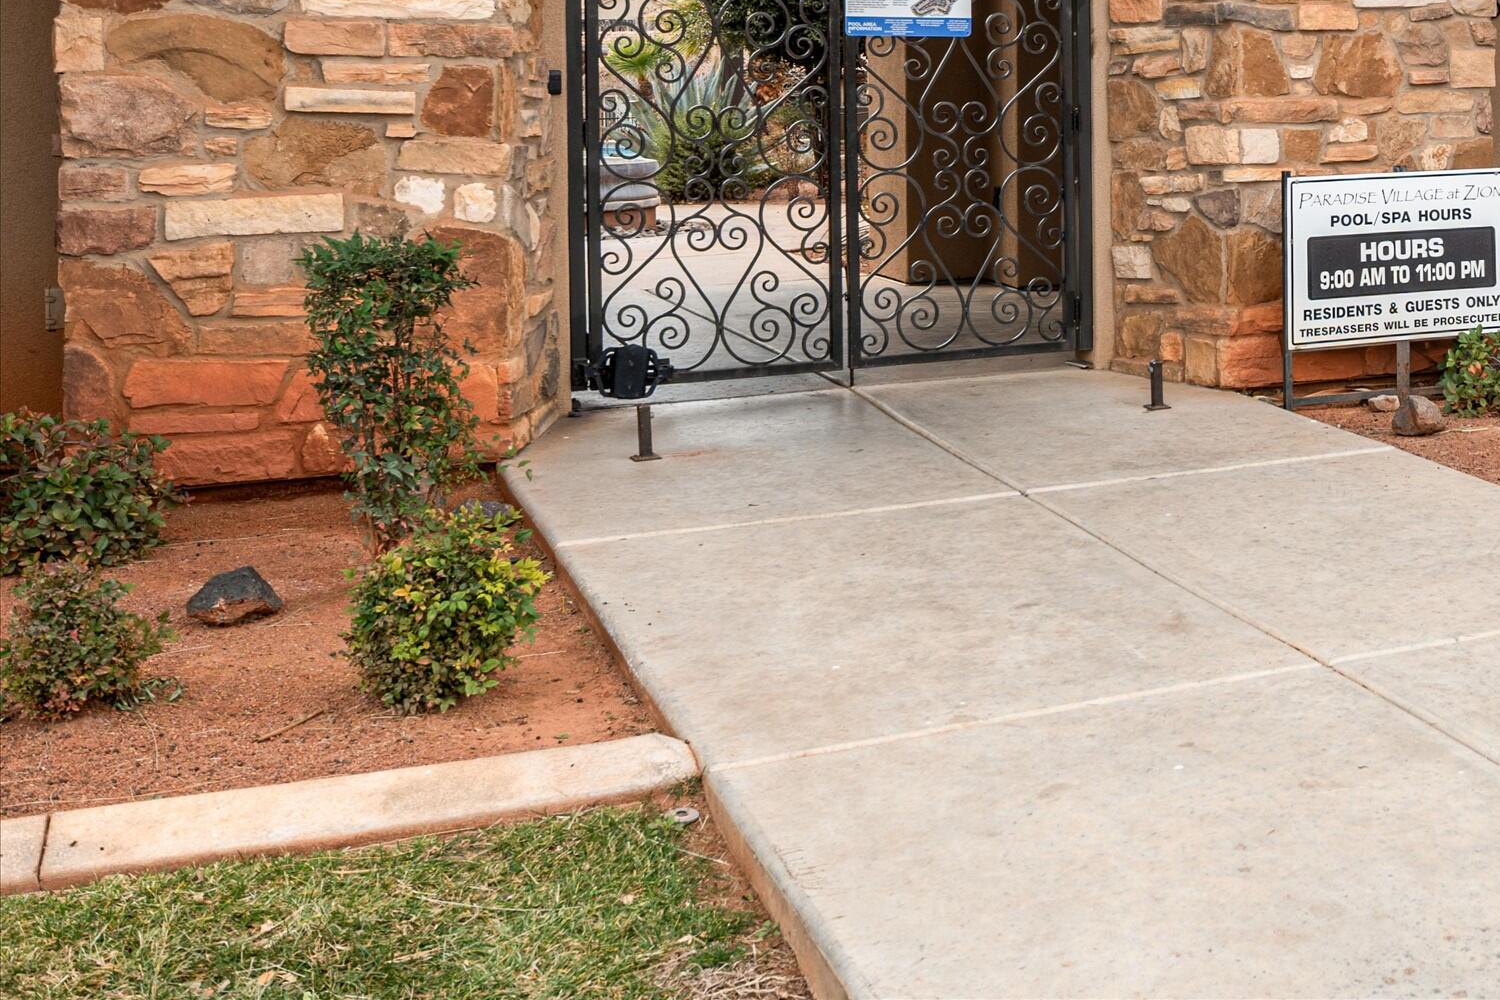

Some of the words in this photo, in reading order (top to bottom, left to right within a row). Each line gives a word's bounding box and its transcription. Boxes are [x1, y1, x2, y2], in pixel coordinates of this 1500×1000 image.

[1299, 190, 1377, 209] PARADISE
[1381, 187, 1444, 205] VILLAGE
[1446, 188, 1460, 200] at
[1330, 211, 1411, 227] POOL/SPA
[1418, 208, 1472, 222] HOURS
[1360, 237, 1444, 262] HOURS
[1320, 269, 1354, 290] 9:00
[1359, 266, 1386, 287] AM
[1390, 265, 1410, 284] TO
[1415, 262, 1456, 282] 11:00
[1460, 260, 1485, 279] PM
[1303, 303, 1382, 321] RESIDENTS
[1389, 302, 1398, 314] &
[1405, 297, 1460, 313] GUESTS
[1466, 294, 1500, 308] ONLY
[1300, 322, 1379, 338] TRESPASSERS
[1384, 319, 1410, 331] WILL
[1414, 318, 1429, 328] BE
